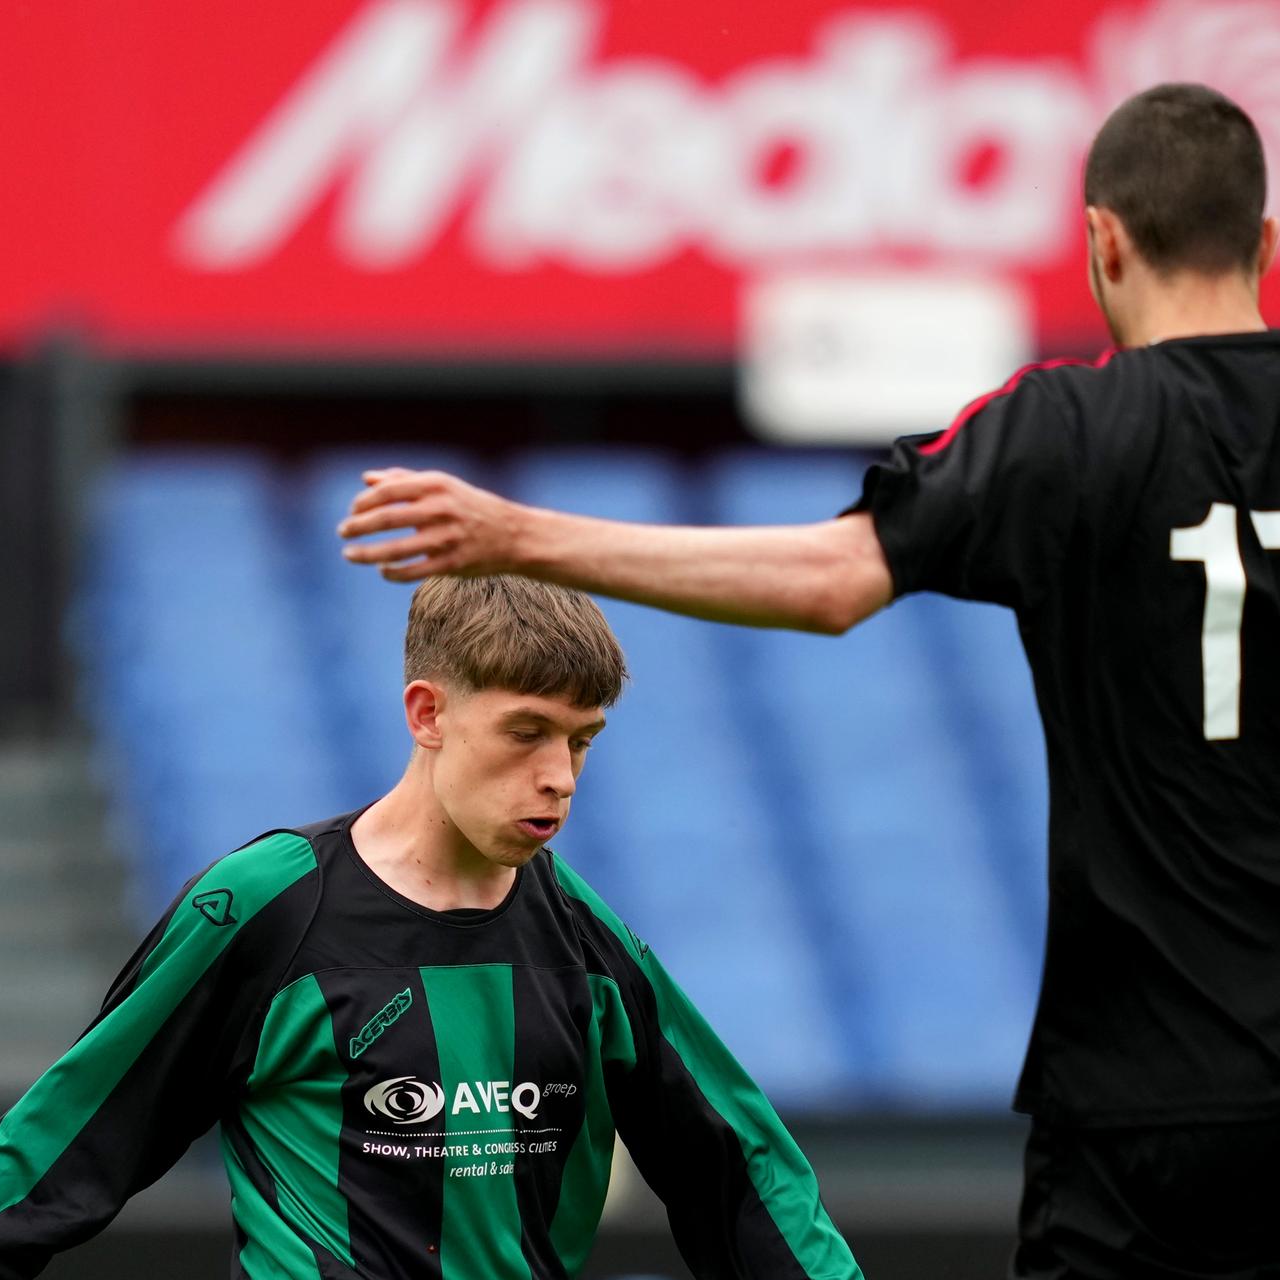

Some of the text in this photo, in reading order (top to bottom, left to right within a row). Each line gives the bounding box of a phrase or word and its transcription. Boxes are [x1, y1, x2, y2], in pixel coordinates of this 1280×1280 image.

[451, 1081, 577, 1120] AVEQ groep
[363, 1142, 410, 1159] SHOW,
[414, 1145, 469, 1158] THEATRE
[472, 1144, 482, 1155] &
[485, 1142, 526, 1155] CONGESS
[449, 1162, 488, 1177] rental
[490, 1161, 498, 1175] &
